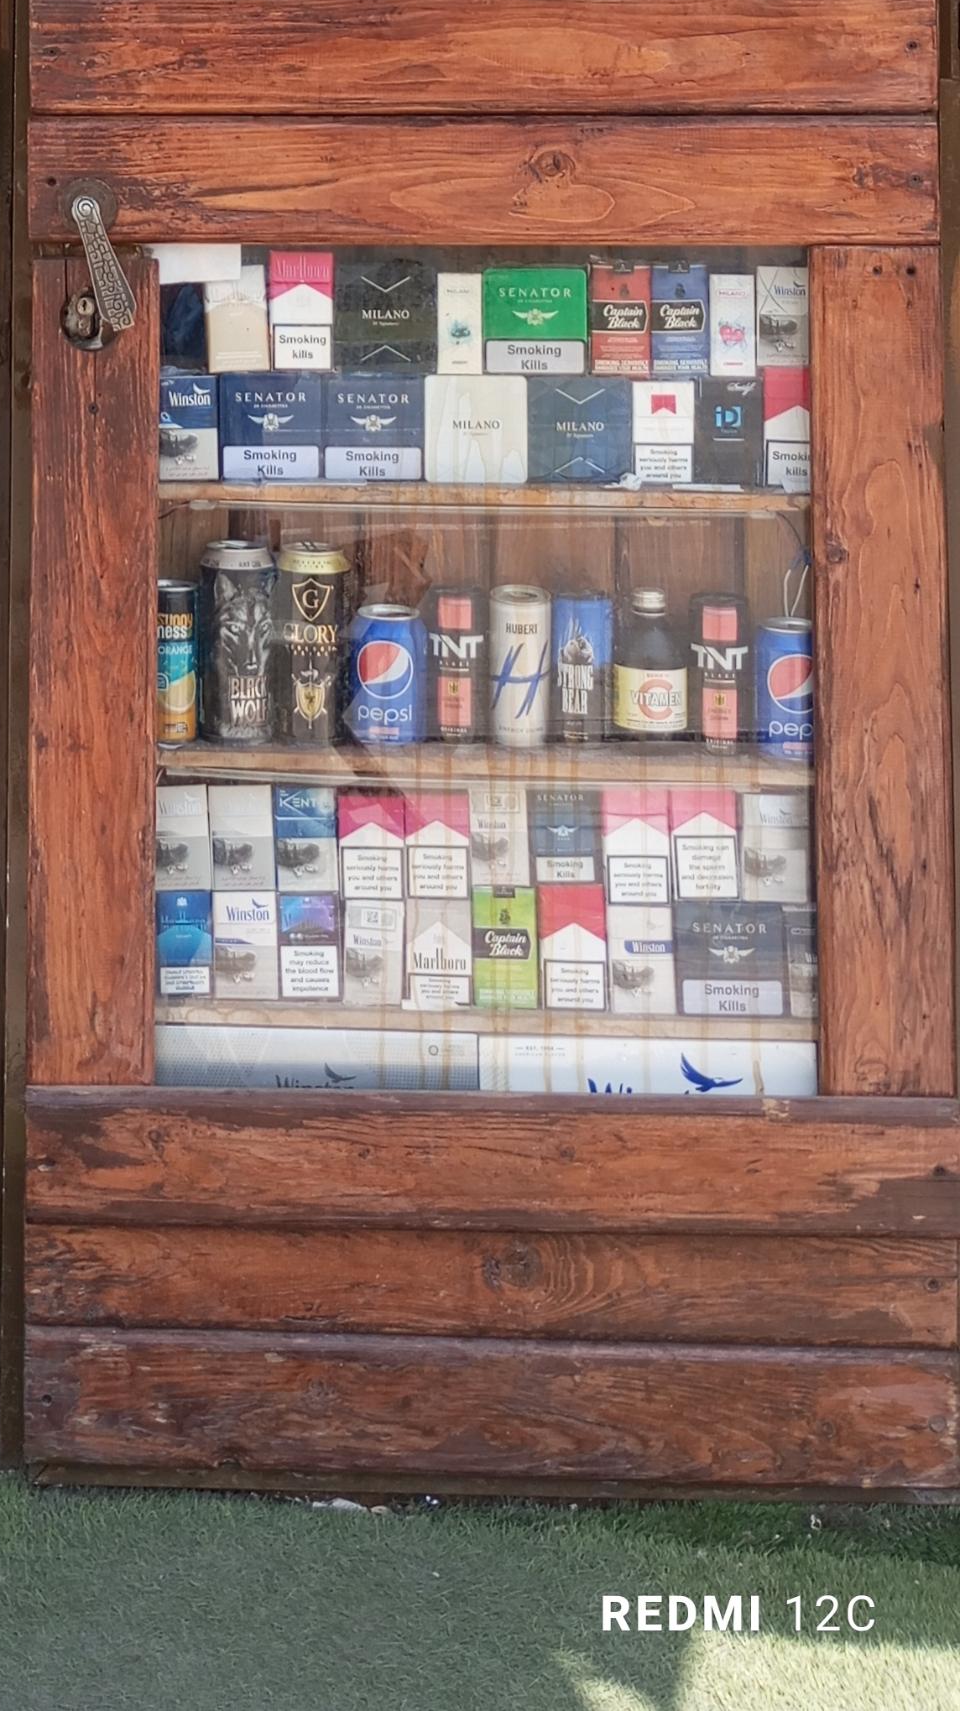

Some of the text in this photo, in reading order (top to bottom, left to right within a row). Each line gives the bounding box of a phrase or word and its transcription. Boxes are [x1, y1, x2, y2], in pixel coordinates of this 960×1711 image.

[499, 287, 572, 298] SENATOR
[774, 284, 806, 297] Winston
[362, 309, 410, 320] MILANO
[603, 305, 644, 319] Captain
[659, 305, 700, 319] Captain
[607, 316, 642, 330] Black
[664, 316, 699, 330] Black
[279, 334, 327, 347] Smoking
[291, 348, 314, 360] kills
[507, 344, 561, 357] Smoking
[521, 359, 548, 371] Kills
[169, 390, 211, 407] Winston
[235, 392, 306, 402] SENATOR
[337, 393, 410, 404] SENATOR
[452, 420, 500, 430] MILANO
[556, 421, 604, 431] MILANO
[244, 450, 297, 463] Smoking
[345, 451, 399, 464] Smoking
[257, 464, 283, 476] Kills
[359, 465, 386, 477] Kills
[786, 465, 808, 476] kills
[302, 590, 319, 608] G
[284, 624, 337, 643] GLORY
[429, 633, 484, 658] TNT
[691, 643, 748, 670] TNT
[558, 665, 593, 689] STRONG
[230, 676, 268, 698] BLACK
[562, 689, 587, 714] BEAR
[231, 699, 268, 723] WOLF
[358, 704, 412, 724] pepsi
[280, 796, 316, 809] KENT
[547, 860, 583, 870] Smoking
[557, 870, 575, 879] Kills
[226, 905, 269, 921] Winston
[692, 922, 767, 934] SENATOR
[486, 931, 527, 945] Captain
[490, 943, 524, 957] Black
[632, 942, 666, 953] Winston
[705, 984, 759, 997] Smoking
[719, 1000, 746, 1012] Kills
